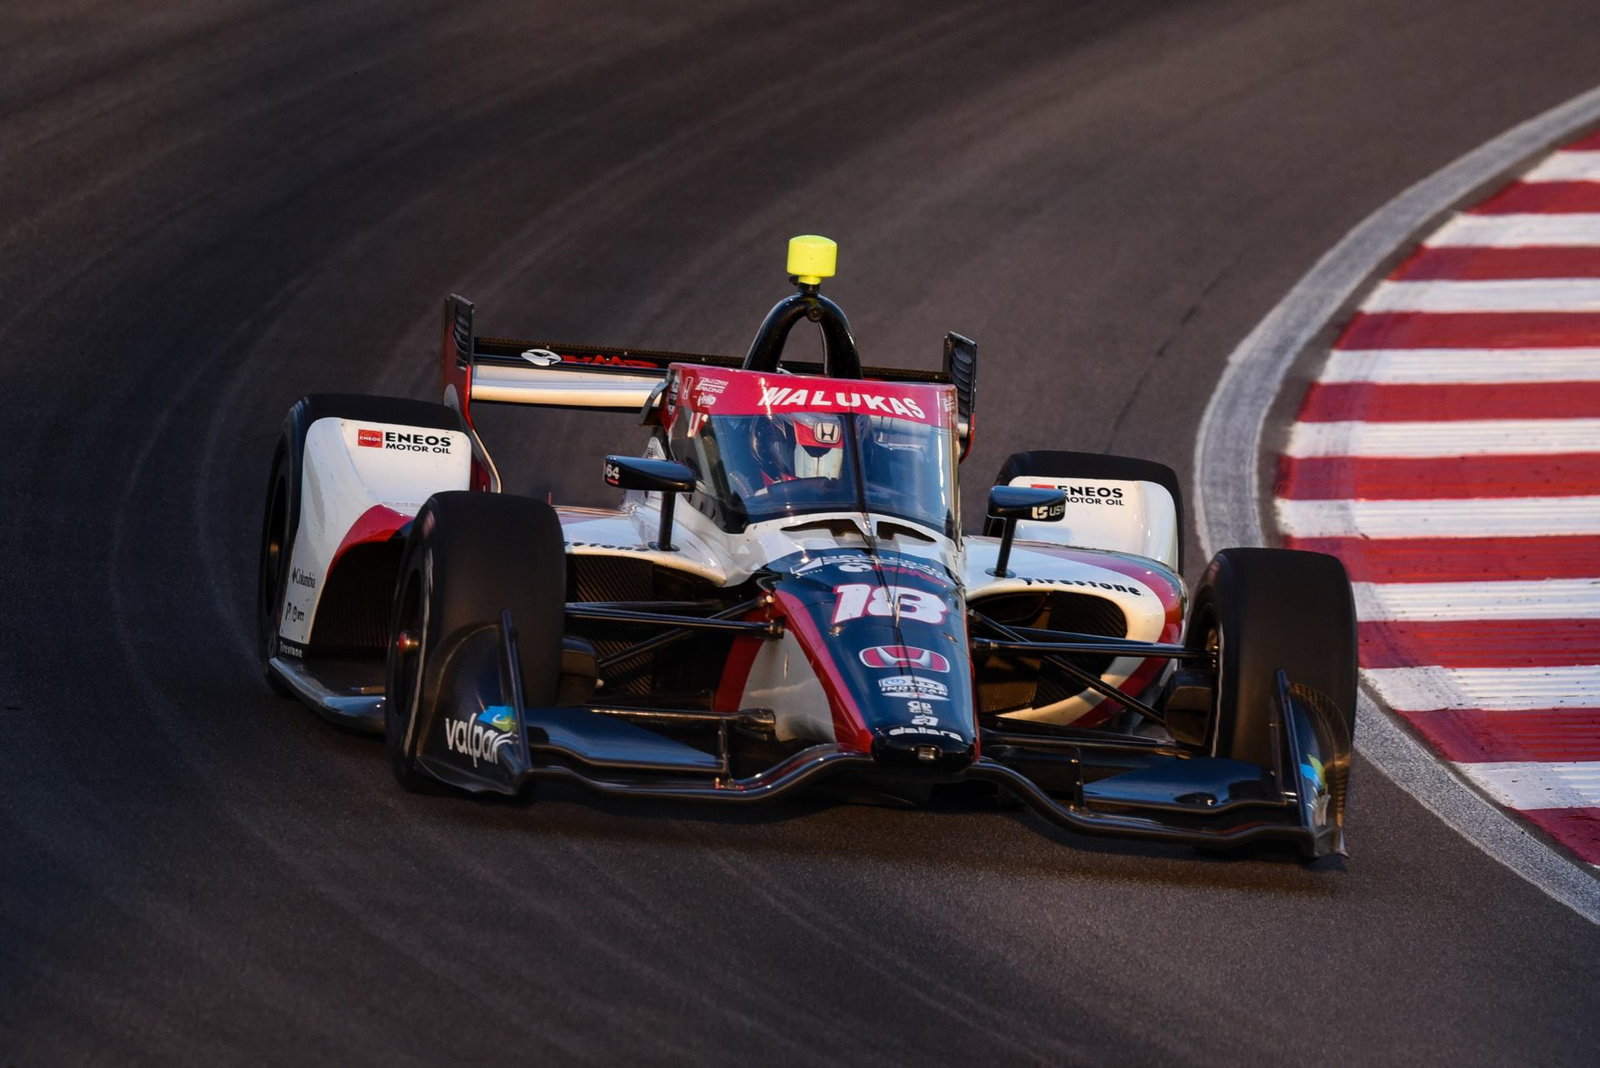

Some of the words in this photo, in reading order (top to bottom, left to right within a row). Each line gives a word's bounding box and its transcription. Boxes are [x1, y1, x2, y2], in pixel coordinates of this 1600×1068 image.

[757, 386, 926, 419] MALUKAS
[359, 435, 382, 443] ENEOS
[385, 432, 452, 447] ENEOS
[386, 443, 429, 453] MOTOR
[1057, 485, 1123, 498] ENEOS
[832, 583, 949, 626] 18
[880, 685, 949, 697] INDYCAR
[888, 726, 963, 743] dallara
